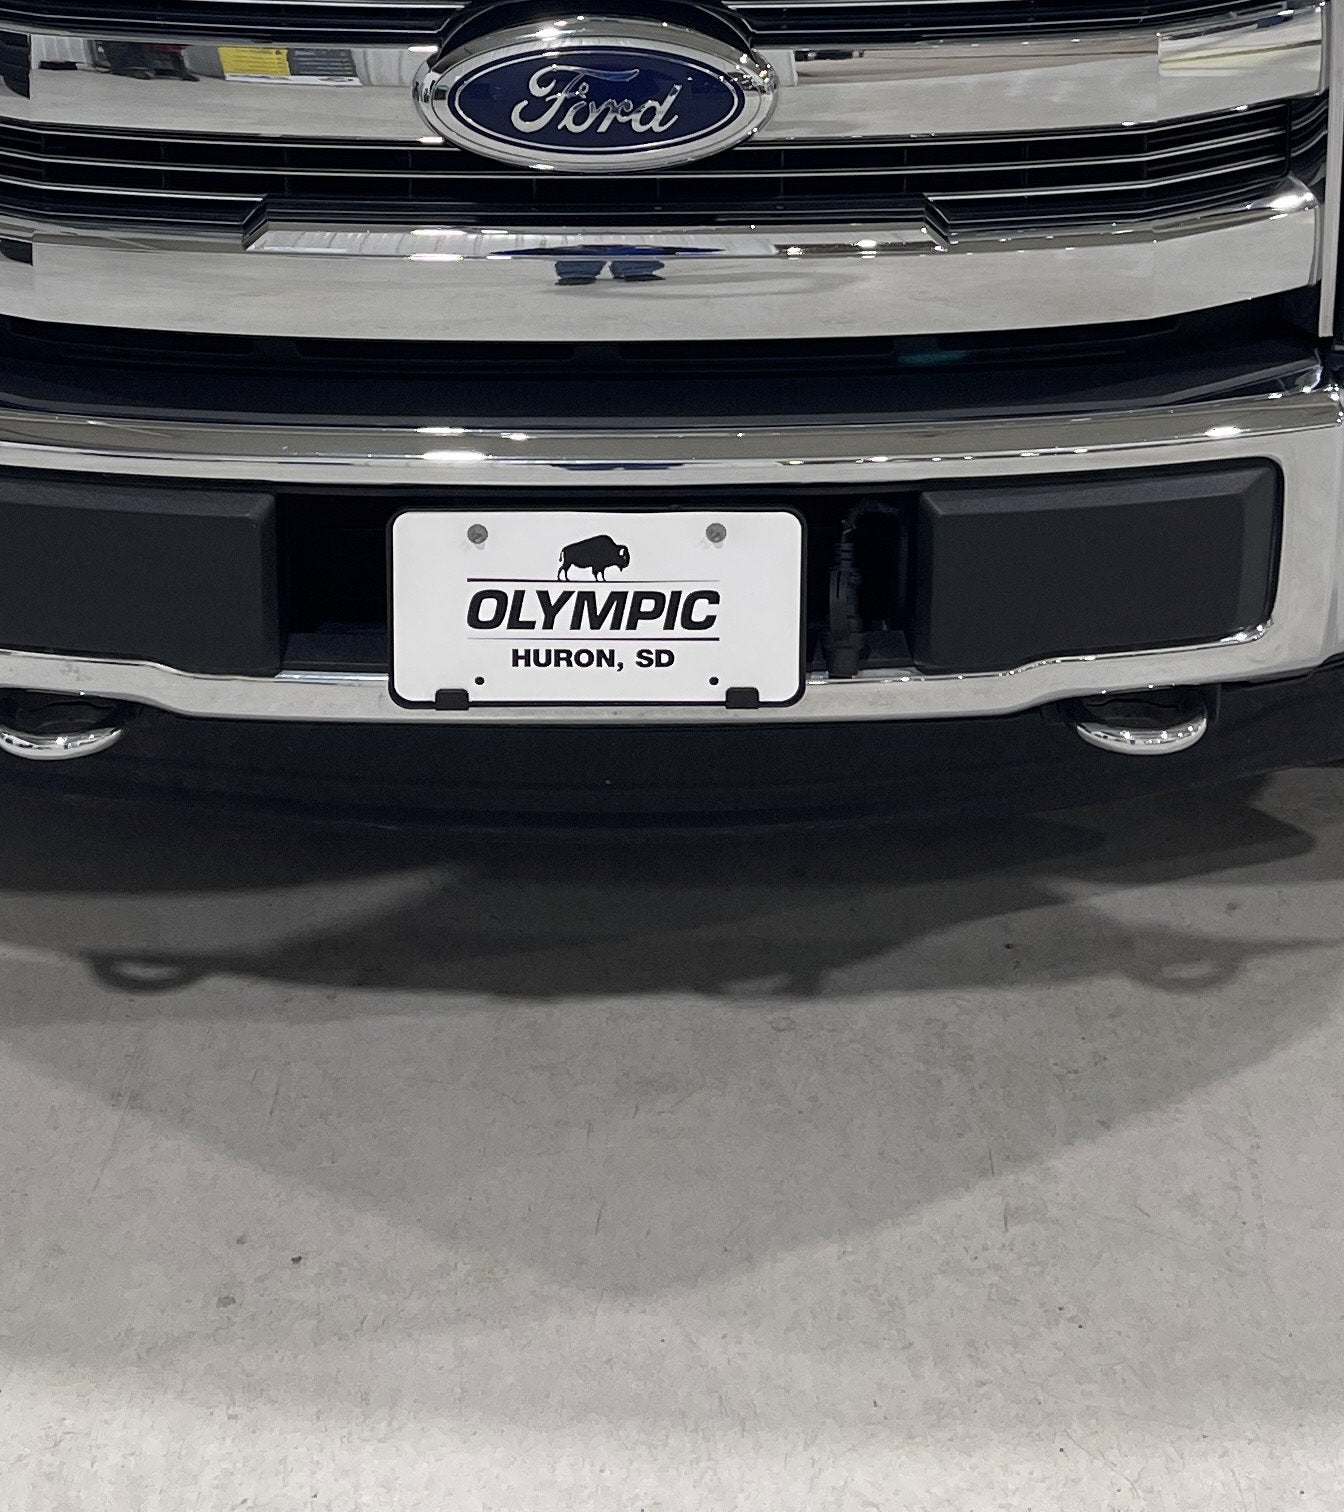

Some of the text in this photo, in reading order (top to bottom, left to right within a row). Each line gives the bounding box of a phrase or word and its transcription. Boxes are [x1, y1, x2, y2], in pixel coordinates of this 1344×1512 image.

[511, 64, 683, 133] Ford
[466, 589, 720, 631] OLYMPIC
[511, 648, 675, 672] HURON, SD
